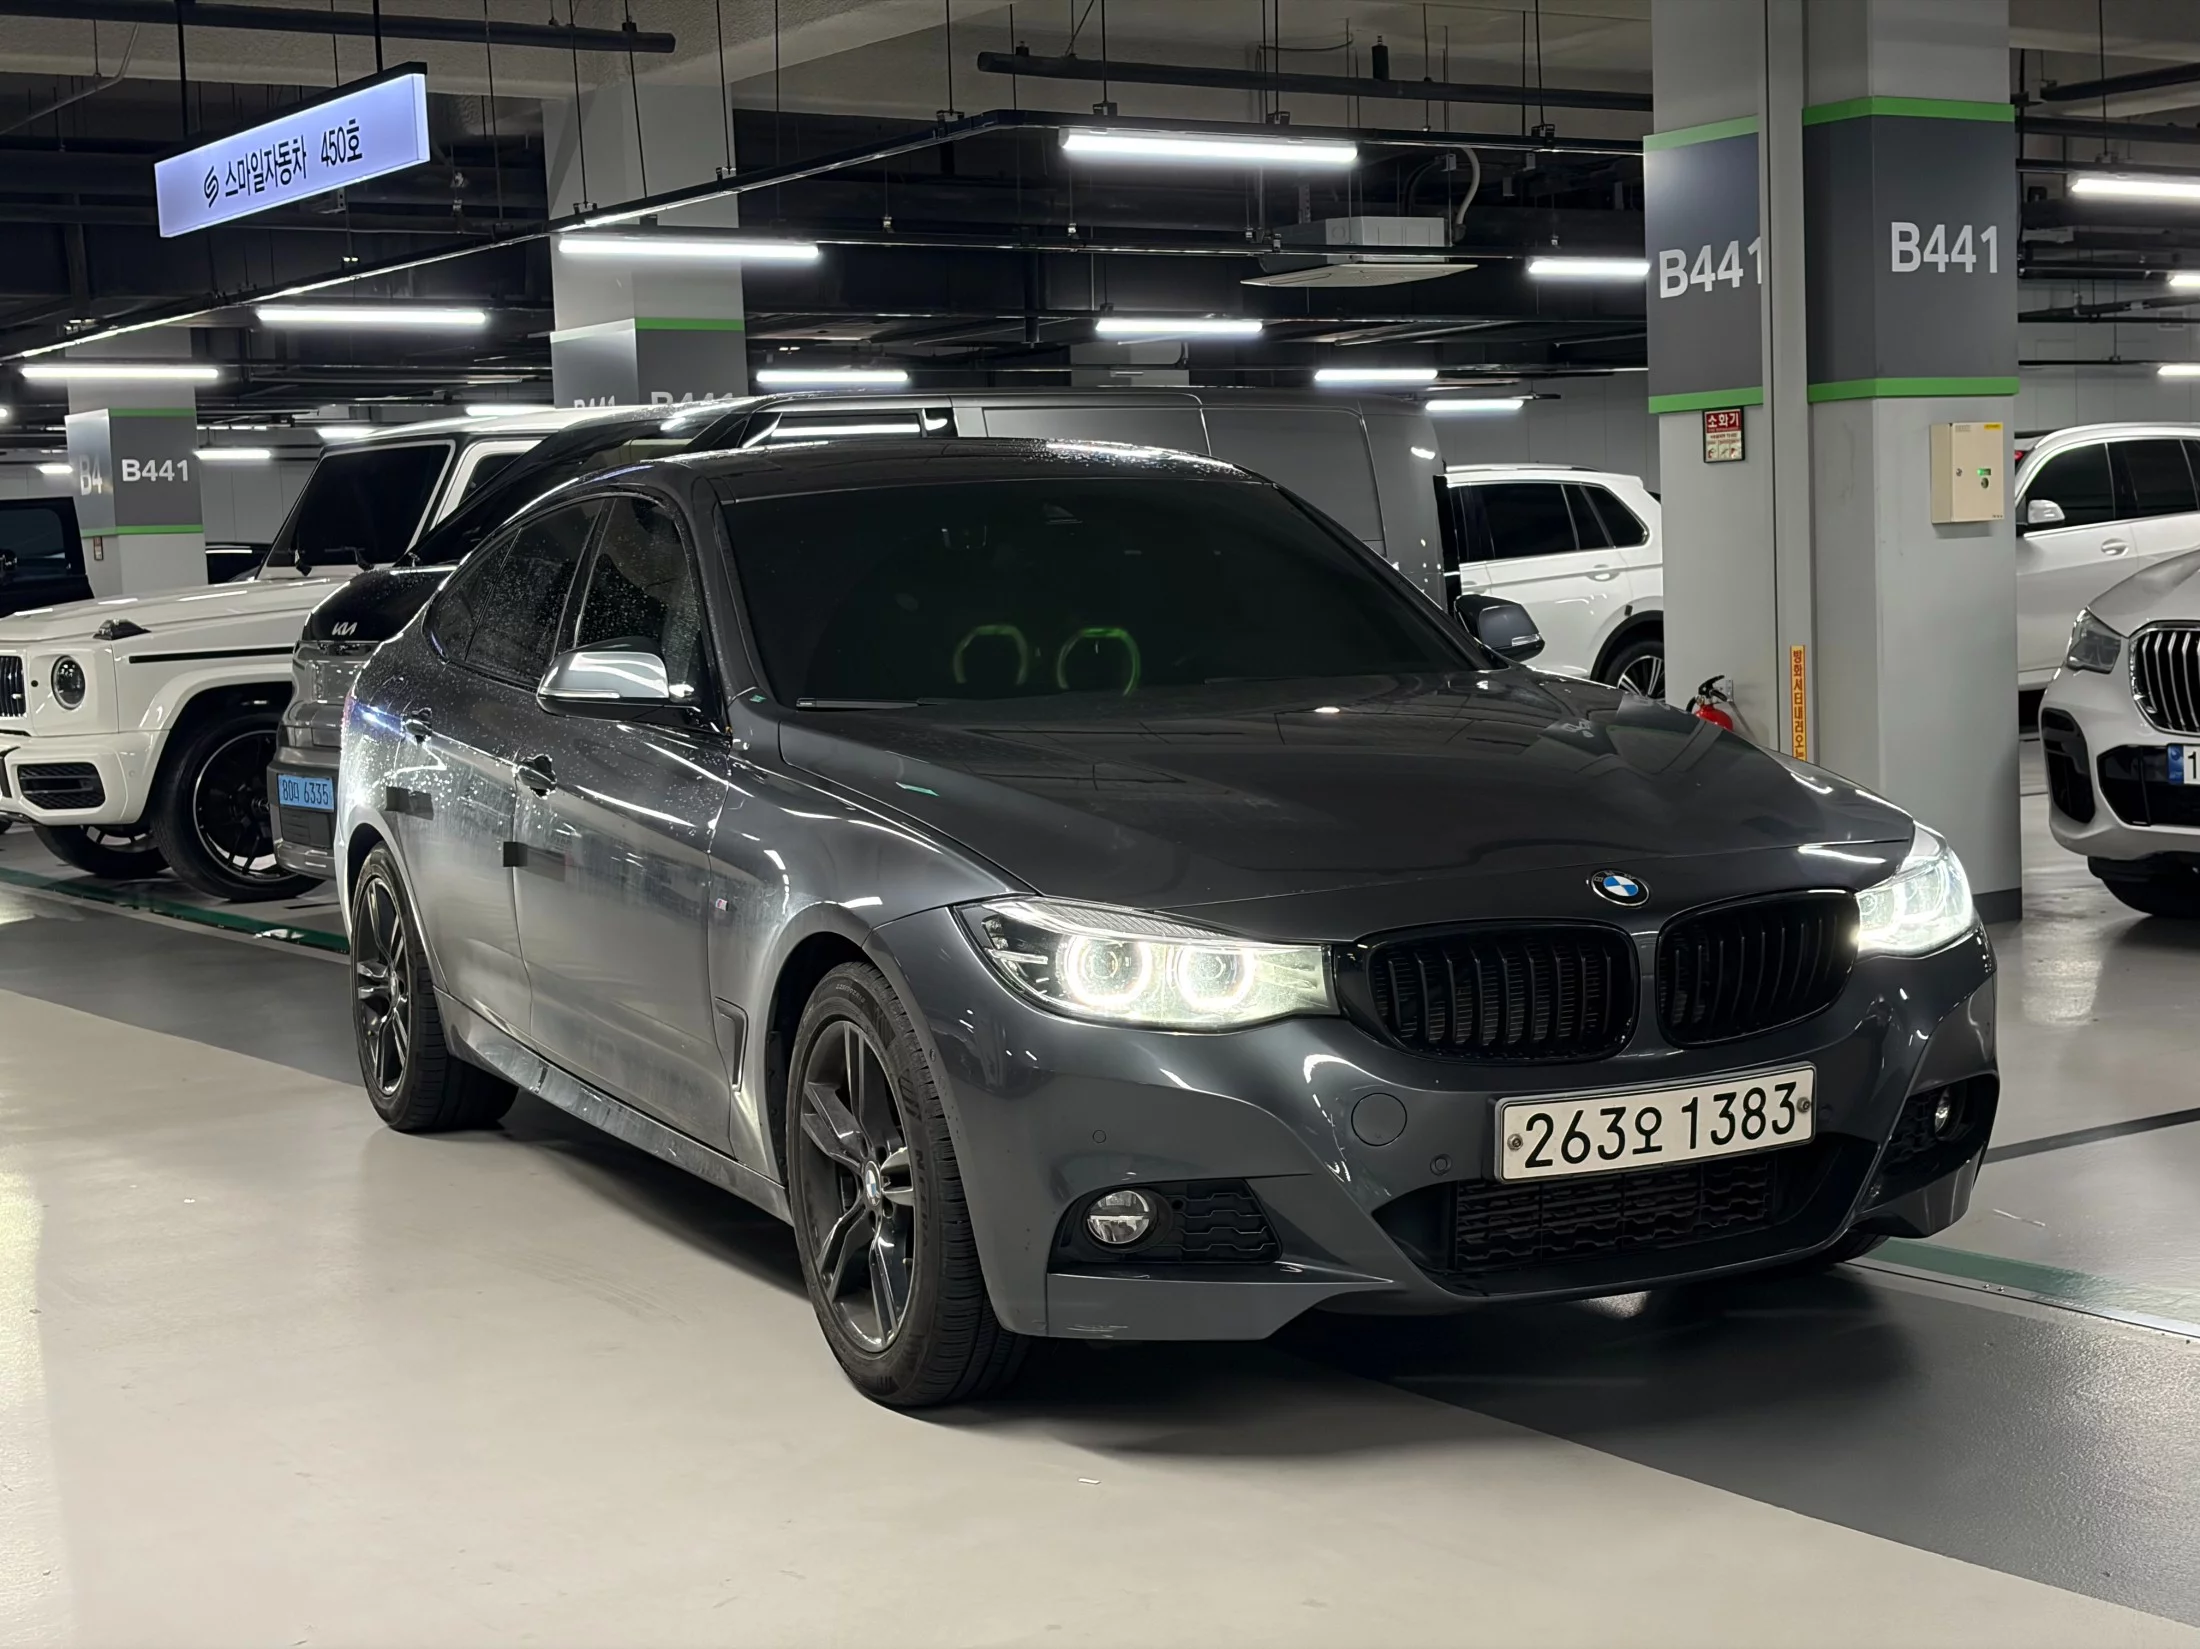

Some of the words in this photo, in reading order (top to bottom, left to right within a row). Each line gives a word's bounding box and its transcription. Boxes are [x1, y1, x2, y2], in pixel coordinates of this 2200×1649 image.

[225, 135, 307, 197] 스마일자동차
[321, 118, 363, 168] 450호
[1891, 221, 1998, 273] B441
[1708, 412, 1739, 428] 소화기
[122, 459, 189, 482] B441
[303, 781, 330, 806] 6335
[1525, 1106, 1663, 1169] 263오
[1681, 1081, 1798, 1150] 1383
